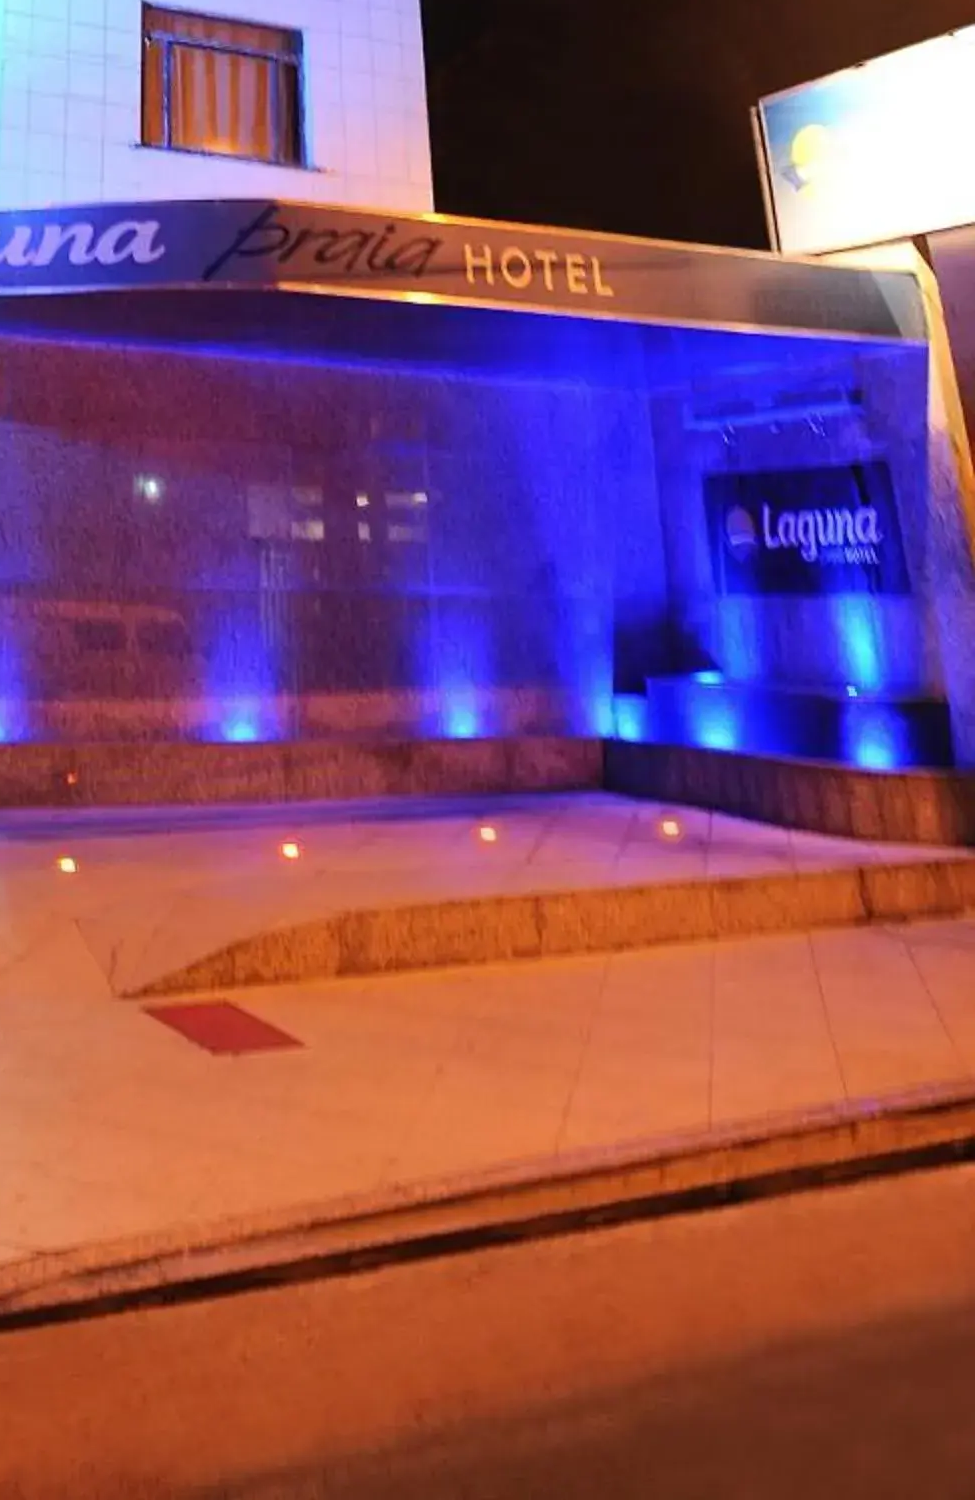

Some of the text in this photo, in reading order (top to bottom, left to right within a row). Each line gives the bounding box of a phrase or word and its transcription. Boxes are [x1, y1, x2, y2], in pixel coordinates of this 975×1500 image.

[202, 202, 445, 282] praia
[462, 242, 615, 298] HOTEL
[762, 502, 884, 563] Laguna
